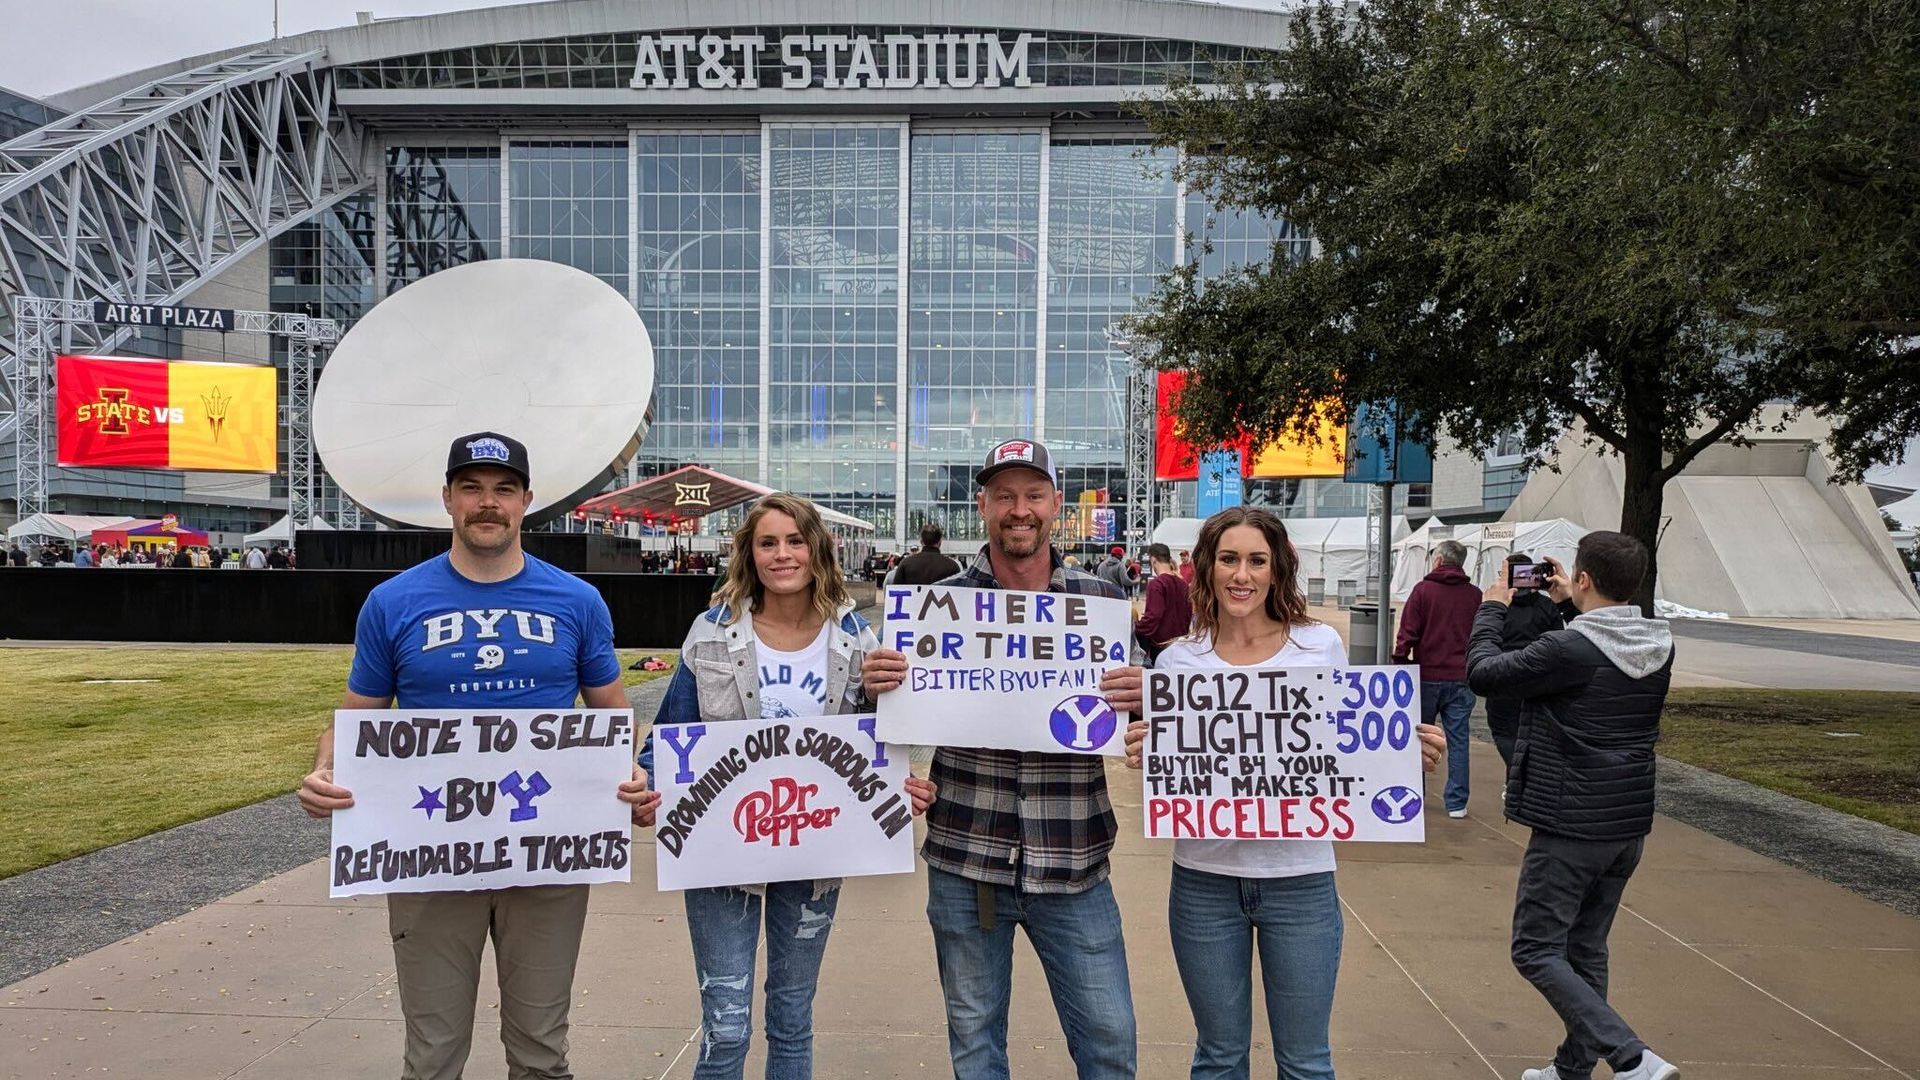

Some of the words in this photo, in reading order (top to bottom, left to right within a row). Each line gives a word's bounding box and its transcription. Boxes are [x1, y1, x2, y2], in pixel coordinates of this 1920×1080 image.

[630, 35, 765, 89] AT&T
[781, 33, 1032, 89] STADIUM
[105, 304, 154, 324] AT&T
[161, 307, 224, 328] PLAZA
[77, 402, 151, 425] STATE
[153, 407, 184, 424] VS
[473, 443, 507, 460] BYU
[887, 586, 960, 621] I'M
[975, 591, 1088, 626] HERE
[422, 609, 556, 651] BYU
[896, 631, 964, 660] FOR
[976, 632, 1054, 660] THE
[1065, 633, 1125, 663] BBQ
[450, 679, 535, 693] FOOTBALL
[912, 667, 995, 692] BITTER
[1000, 669, 1039, 693] BYU
[1042, 667, 1105, 689] FAN!
[1332, 669, 1414, 709] $300
[355, 718, 462, 758] NOTE
[473, 716, 518, 752] TO
[529, 713, 631, 750] SELF:
[1151, 712, 1323, 755] FLIGHTS:
[1326, 710, 1411, 754] $500
[660, 724, 706, 784] Y
[1148, 755, 1228, 776] BUYING
[1240, 755, 1266, 776] B4
[1278, 756, 1339, 776] YOUR
[445, 770, 552, 822] BUY
[745, 724, 790, 762] OUR
[795, 727, 888, 802] SORROWS
[871, 793, 913, 839] IN
[769, 777, 818, 817] Dr
[1147, 776, 1212, 796] TEAM
[1231, 776, 1318, 797] MAKES
[1330, 776, 1365, 797] IT:
[733, 791, 840, 847] Pepper
[1150, 796, 1355, 840] PRICELESS
[333, 837, 513, 887] REFUNDABLE
[520, 830, 630, 873] TICKETS
